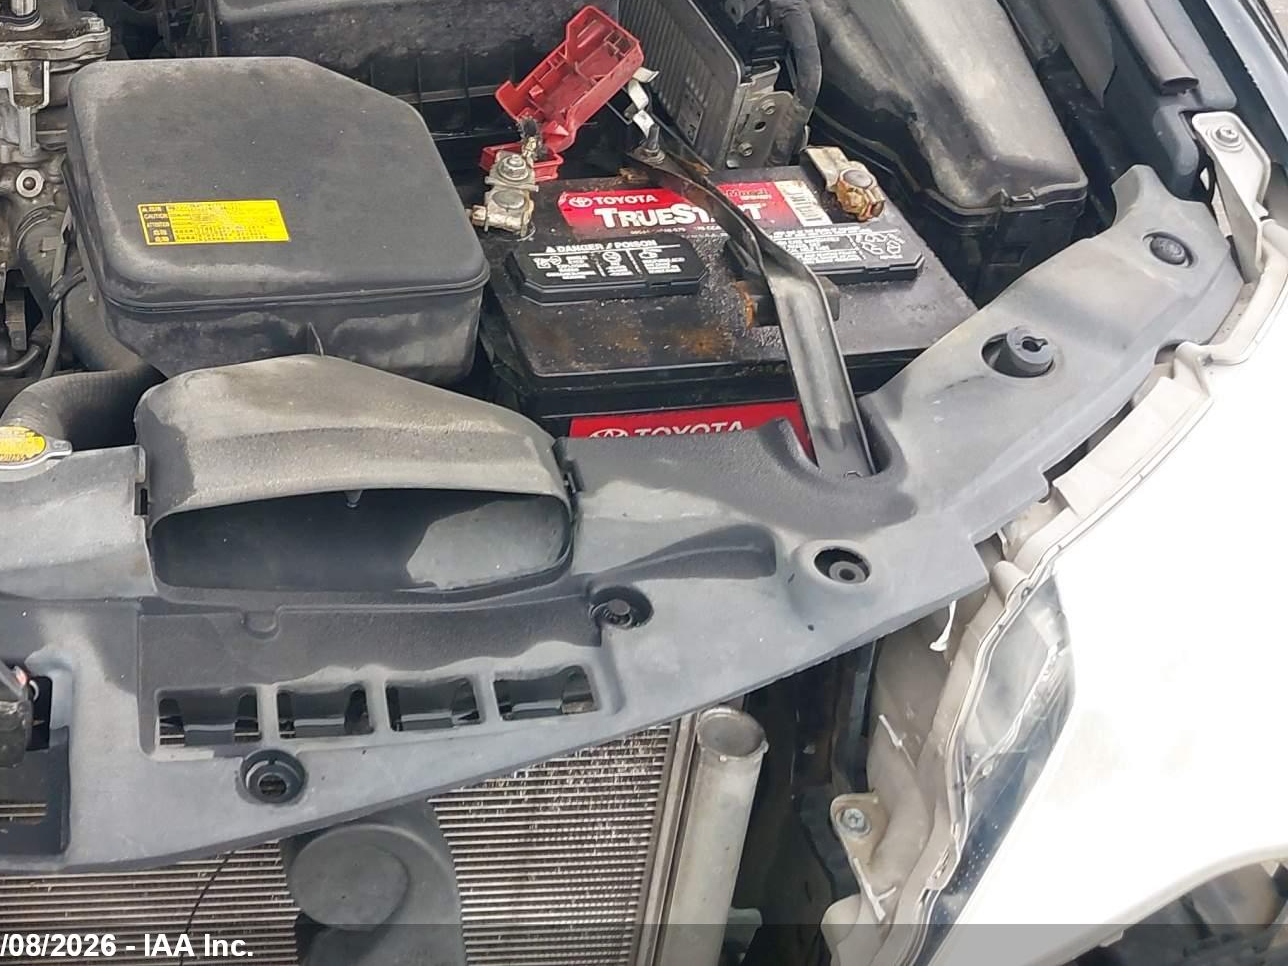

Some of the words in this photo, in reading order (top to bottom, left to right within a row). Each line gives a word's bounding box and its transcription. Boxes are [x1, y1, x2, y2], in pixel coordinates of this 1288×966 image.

[593, 194, 658, 205] TOYOTA
[556, 242, 605, 253] DANGER
[614, 239, 658, 249] POISON
